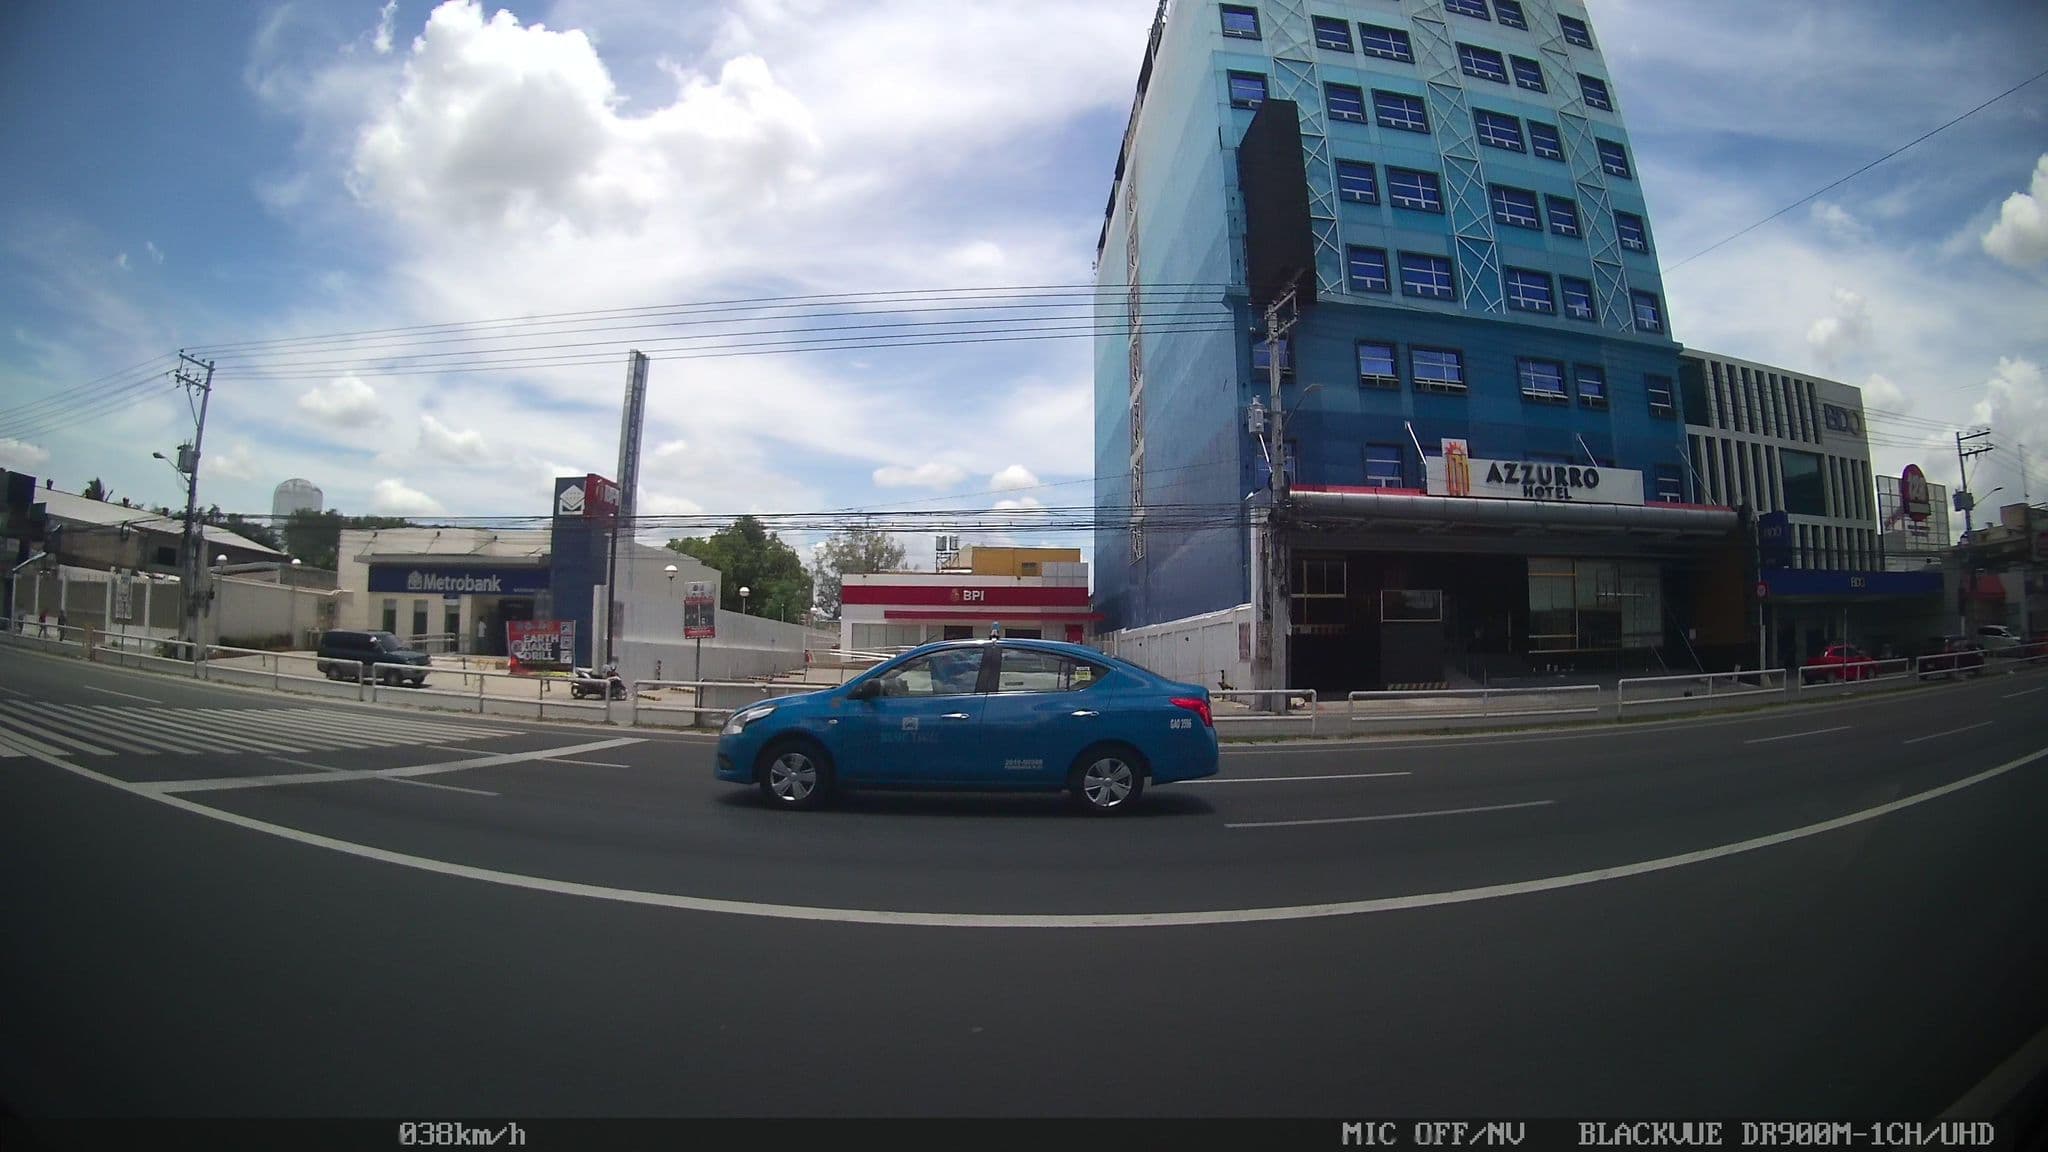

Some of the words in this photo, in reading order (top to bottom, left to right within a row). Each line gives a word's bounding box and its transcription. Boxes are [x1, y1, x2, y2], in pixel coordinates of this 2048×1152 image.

[1486, 462, 1600, 489] AZZURRO
[1523, 485, 1573, 499] HOTEL
[423, 573, 501, 592] Metrobank
[963, 590, 985, 601] BPI
[523, 634, 560, 643] EARTH
[523, 651, 555, 661] DRILL
